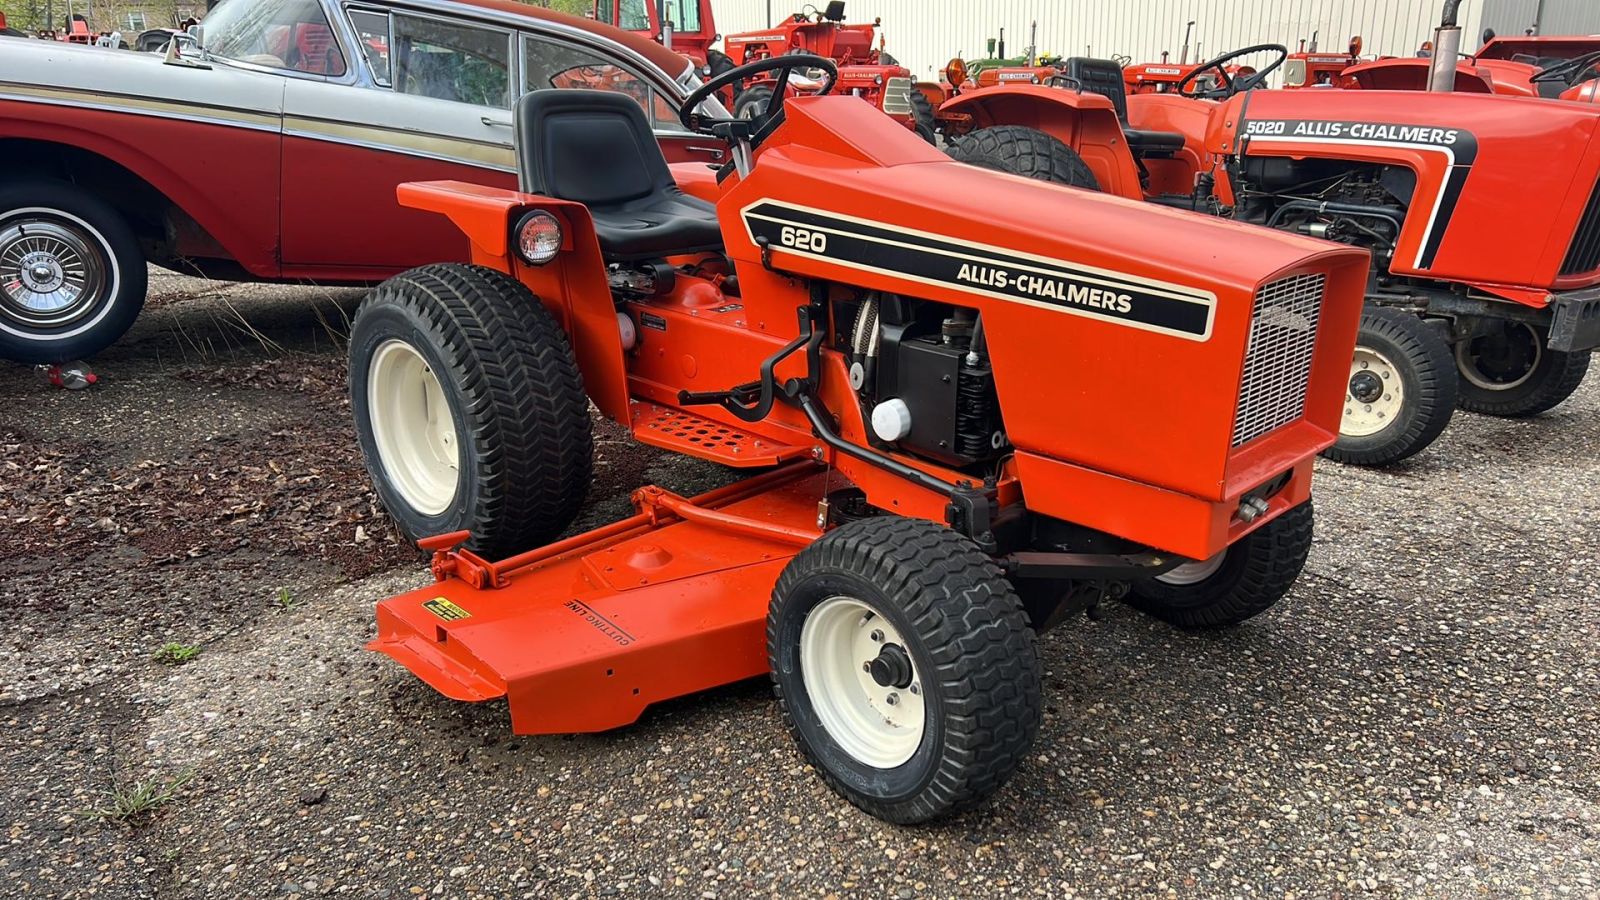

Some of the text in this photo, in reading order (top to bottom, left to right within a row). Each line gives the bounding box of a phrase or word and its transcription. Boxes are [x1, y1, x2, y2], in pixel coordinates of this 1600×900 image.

[1246, 121, 1459, 145] 5020 ALLIS-CHALMERS
[781, 226, 827, 253] 620
[956, 263, 1133, 314] ALLIS-CHALMERS
[563, 600, 630, 646] CUTTING LINE
